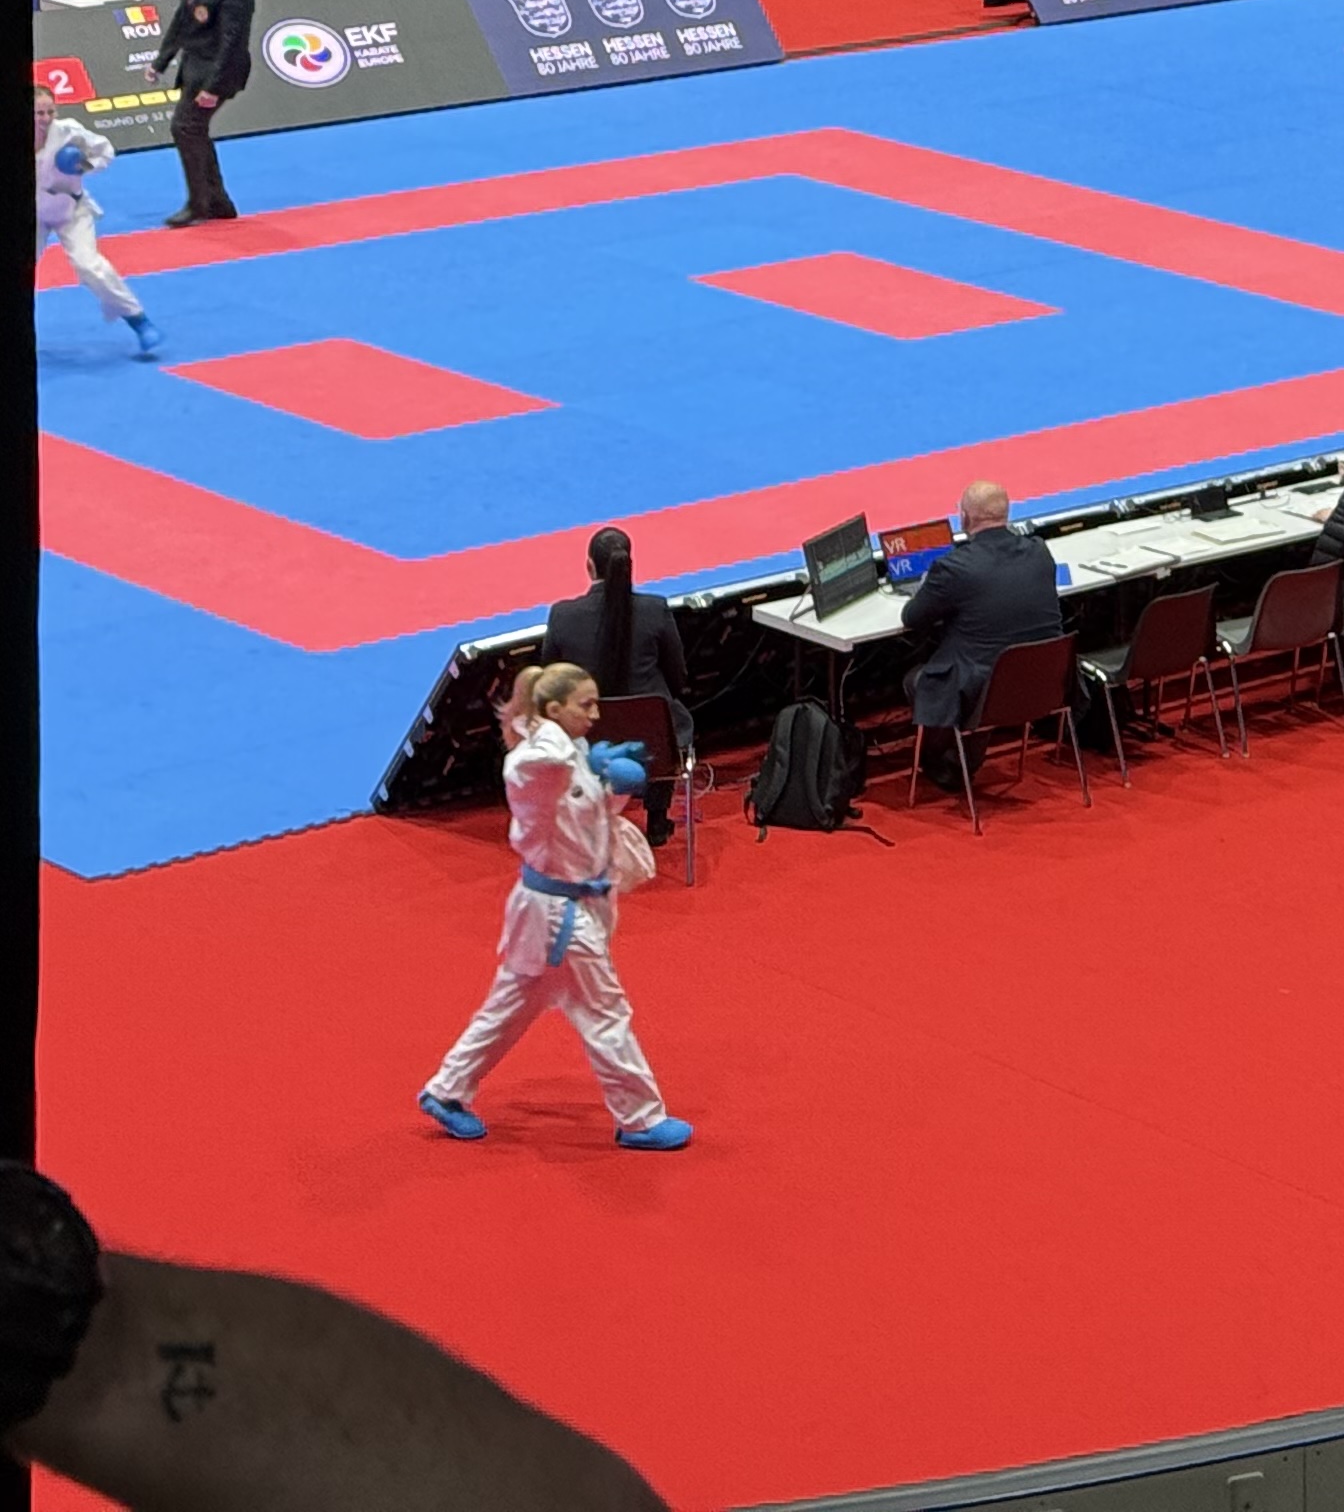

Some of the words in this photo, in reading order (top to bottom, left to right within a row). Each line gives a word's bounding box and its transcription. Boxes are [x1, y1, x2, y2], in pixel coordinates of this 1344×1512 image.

[122, 22, 162, 40] ROU
[344, 22, 398, 47] EKF
[676, 22, 737, 44] HESSEN
[354, 43, 399, 60] KARATE
[529, 41, 593, 64] HESSEN
[602, 32, 665, 55] HESSEN
[684, 42, 701, 56] 80
[702, 36, 744, 54] JAHRE
[357, 53, 405, 70] EUROPE
[537, 61, 556, 76] 80
[557, 56, 600, 74] JAHRE
[610, 51, 629, 67] 80
[629, 46, 671, 64] JAHRE
[48, 69, 74, 95] 2
[884, 537, 907, 554] VR
[890, 558, 913, 576] VR
